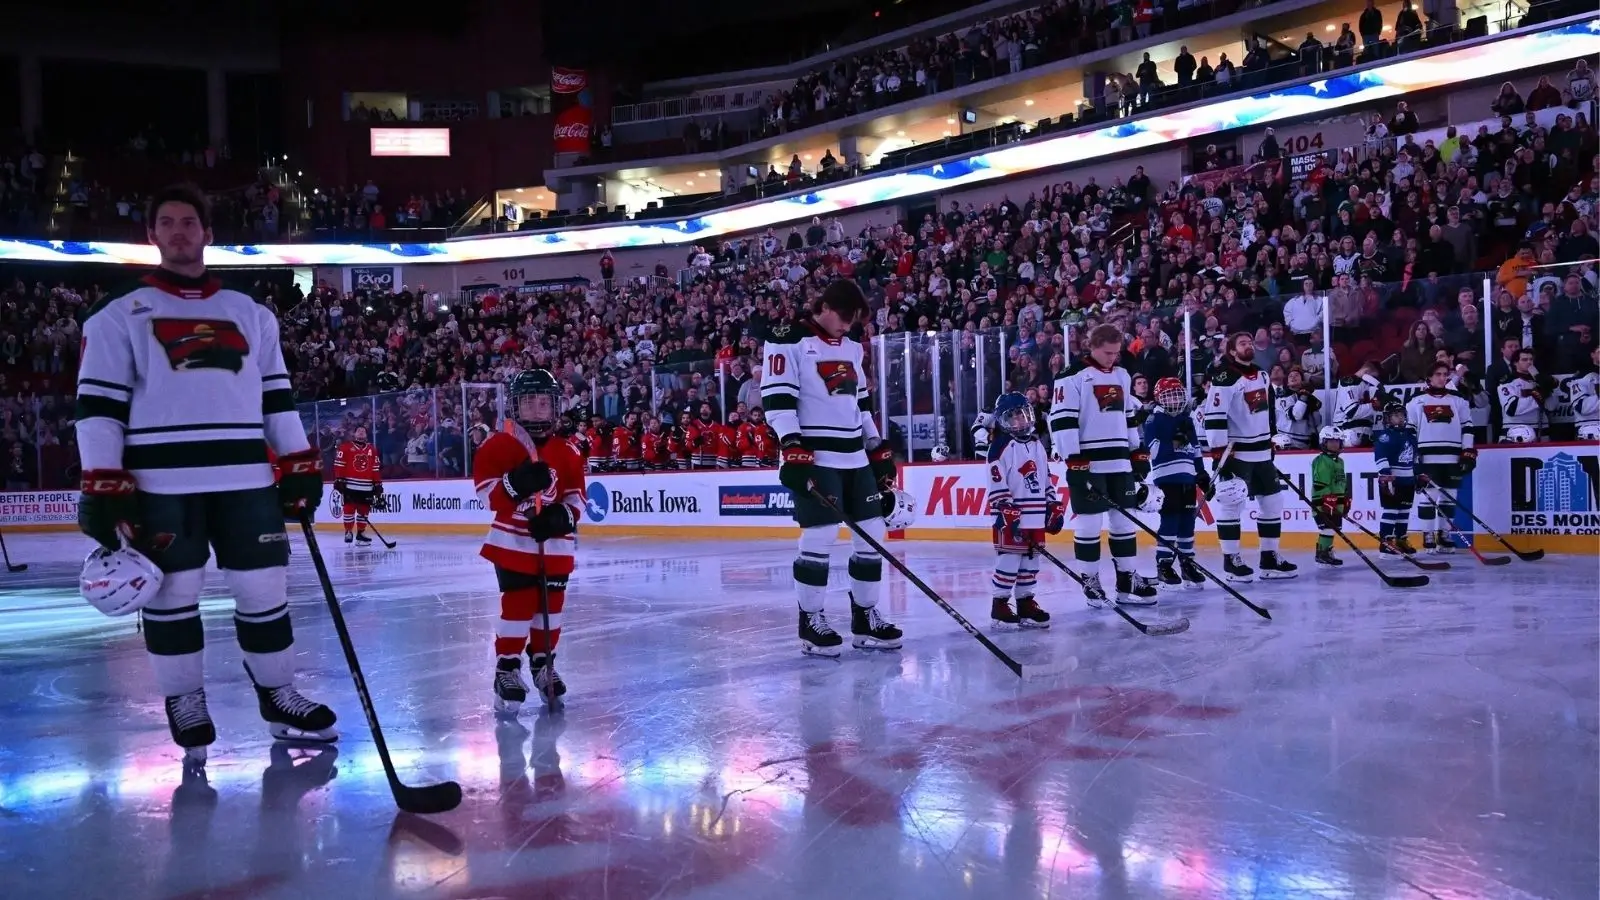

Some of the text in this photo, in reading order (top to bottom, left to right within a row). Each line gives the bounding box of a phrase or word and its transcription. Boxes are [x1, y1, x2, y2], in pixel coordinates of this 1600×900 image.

[1284, 132, 1324, 154] 104
[1292, 165, 1302, 173] IN
[503, 268, 525, 280] 101
[768, 354, 786, 376] 10
[1054, 386, 1064, 404] 14
[1501, 387, 1510, 396] 3
[1213, 393, 1221, 407] 5
[990, 465, 1002, 482] 9
[81, 480, 136, 491] CCM
[0, 493, 75, 503] BETTER PEOPLE.
[412, 493, 461, 510] Mediacom
[611, 490, 653, 513] Bank
[0, 503, 78, 514] ETTER BUILT
[1511, 514, 1547, 527] DES
